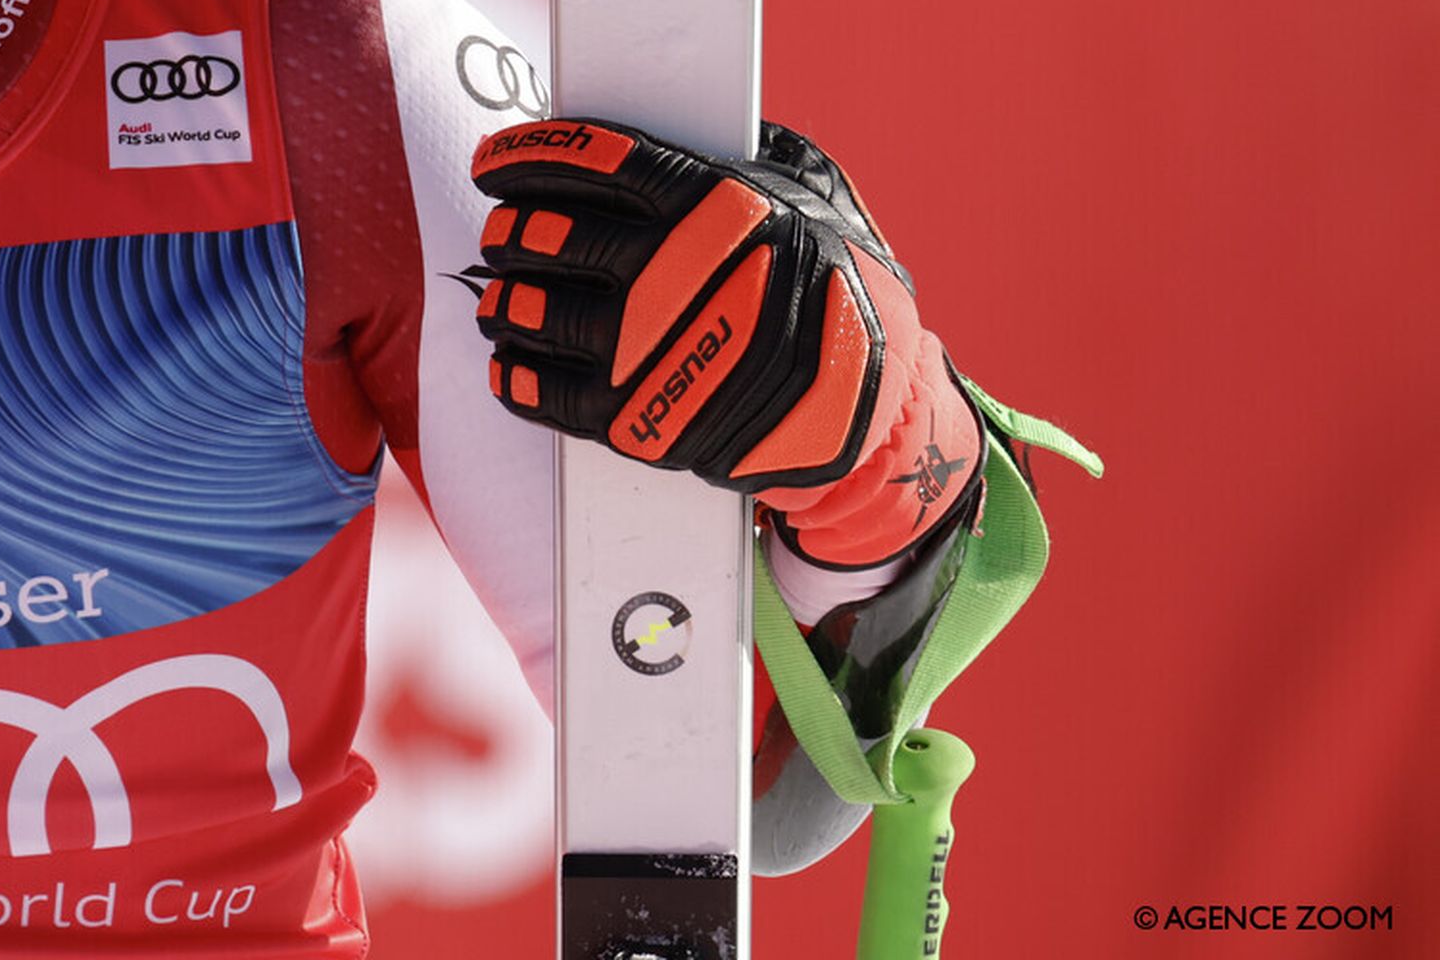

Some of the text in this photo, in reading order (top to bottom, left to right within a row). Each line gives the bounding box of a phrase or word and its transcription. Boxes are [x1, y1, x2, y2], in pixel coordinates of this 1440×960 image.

[118, 123, 153, 134] Audi
[118, 129, 241, 146] FIS Ski World Cup
[629, 315, 733, 443] reusch
[144, 879, 256, 928] Cup
